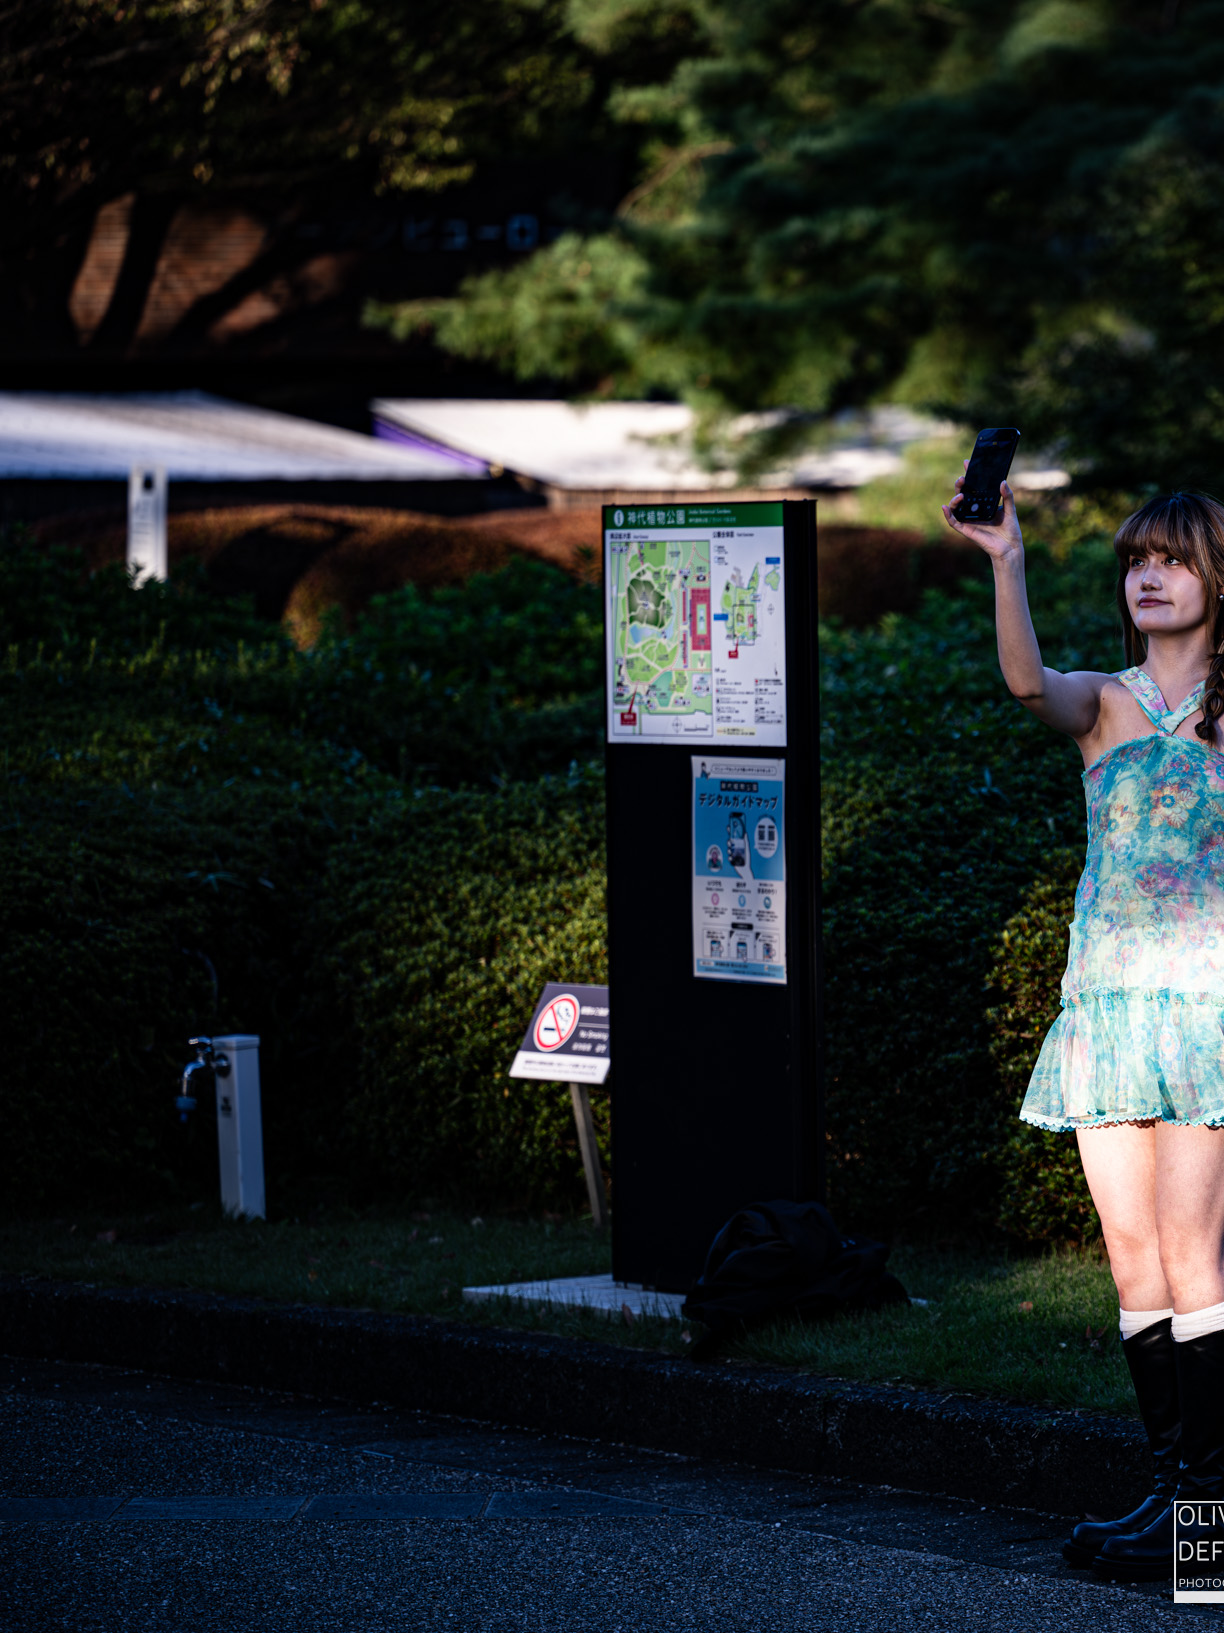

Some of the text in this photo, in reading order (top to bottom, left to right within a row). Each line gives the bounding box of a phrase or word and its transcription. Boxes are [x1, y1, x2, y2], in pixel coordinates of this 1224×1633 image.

[627, 509, 686, 526] 神代植物公園
[699, 794, 778, 811] デジタルガイドマップ
